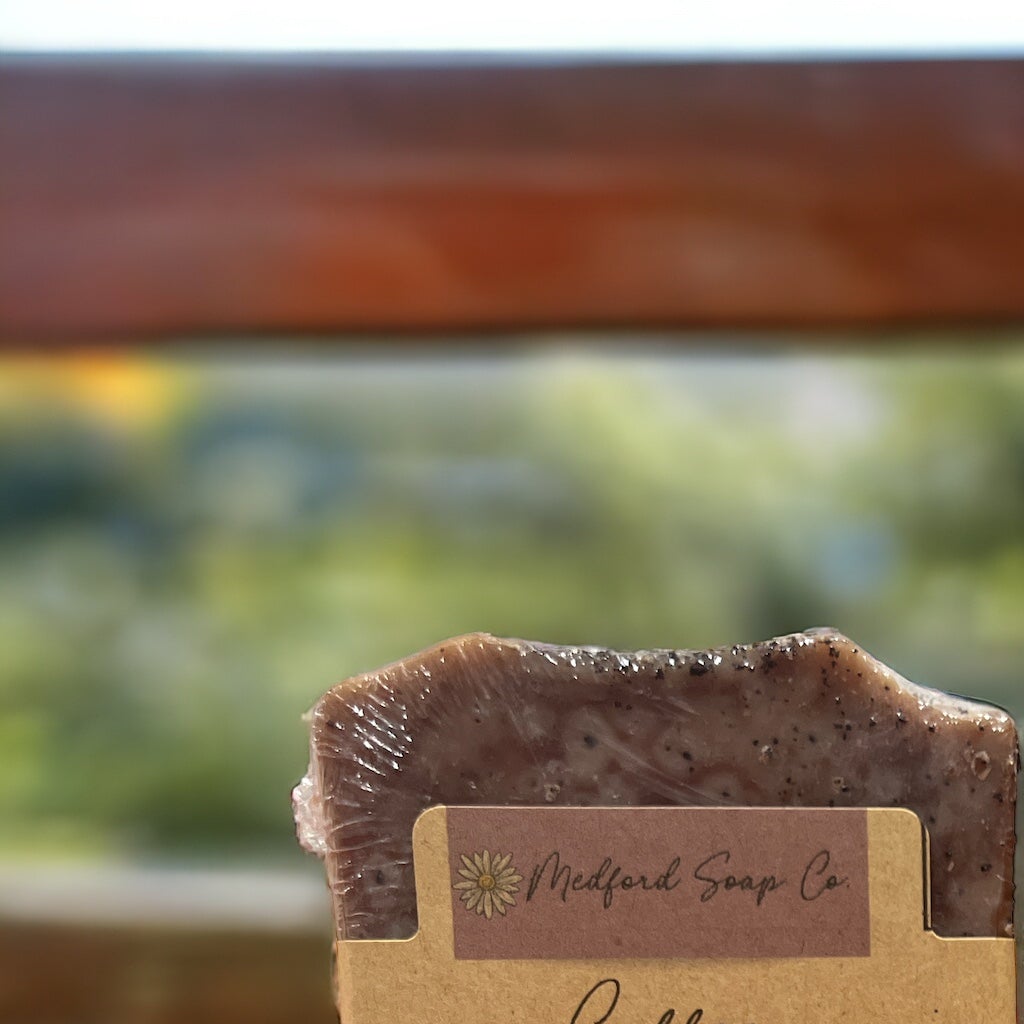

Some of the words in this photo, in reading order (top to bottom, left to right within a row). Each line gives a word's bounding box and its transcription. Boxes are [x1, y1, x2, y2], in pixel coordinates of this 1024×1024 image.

[525, 850, 682, 910] Medford
[693, 850, 788, 907] Soap
[800, 849, 850, 901] Co.
